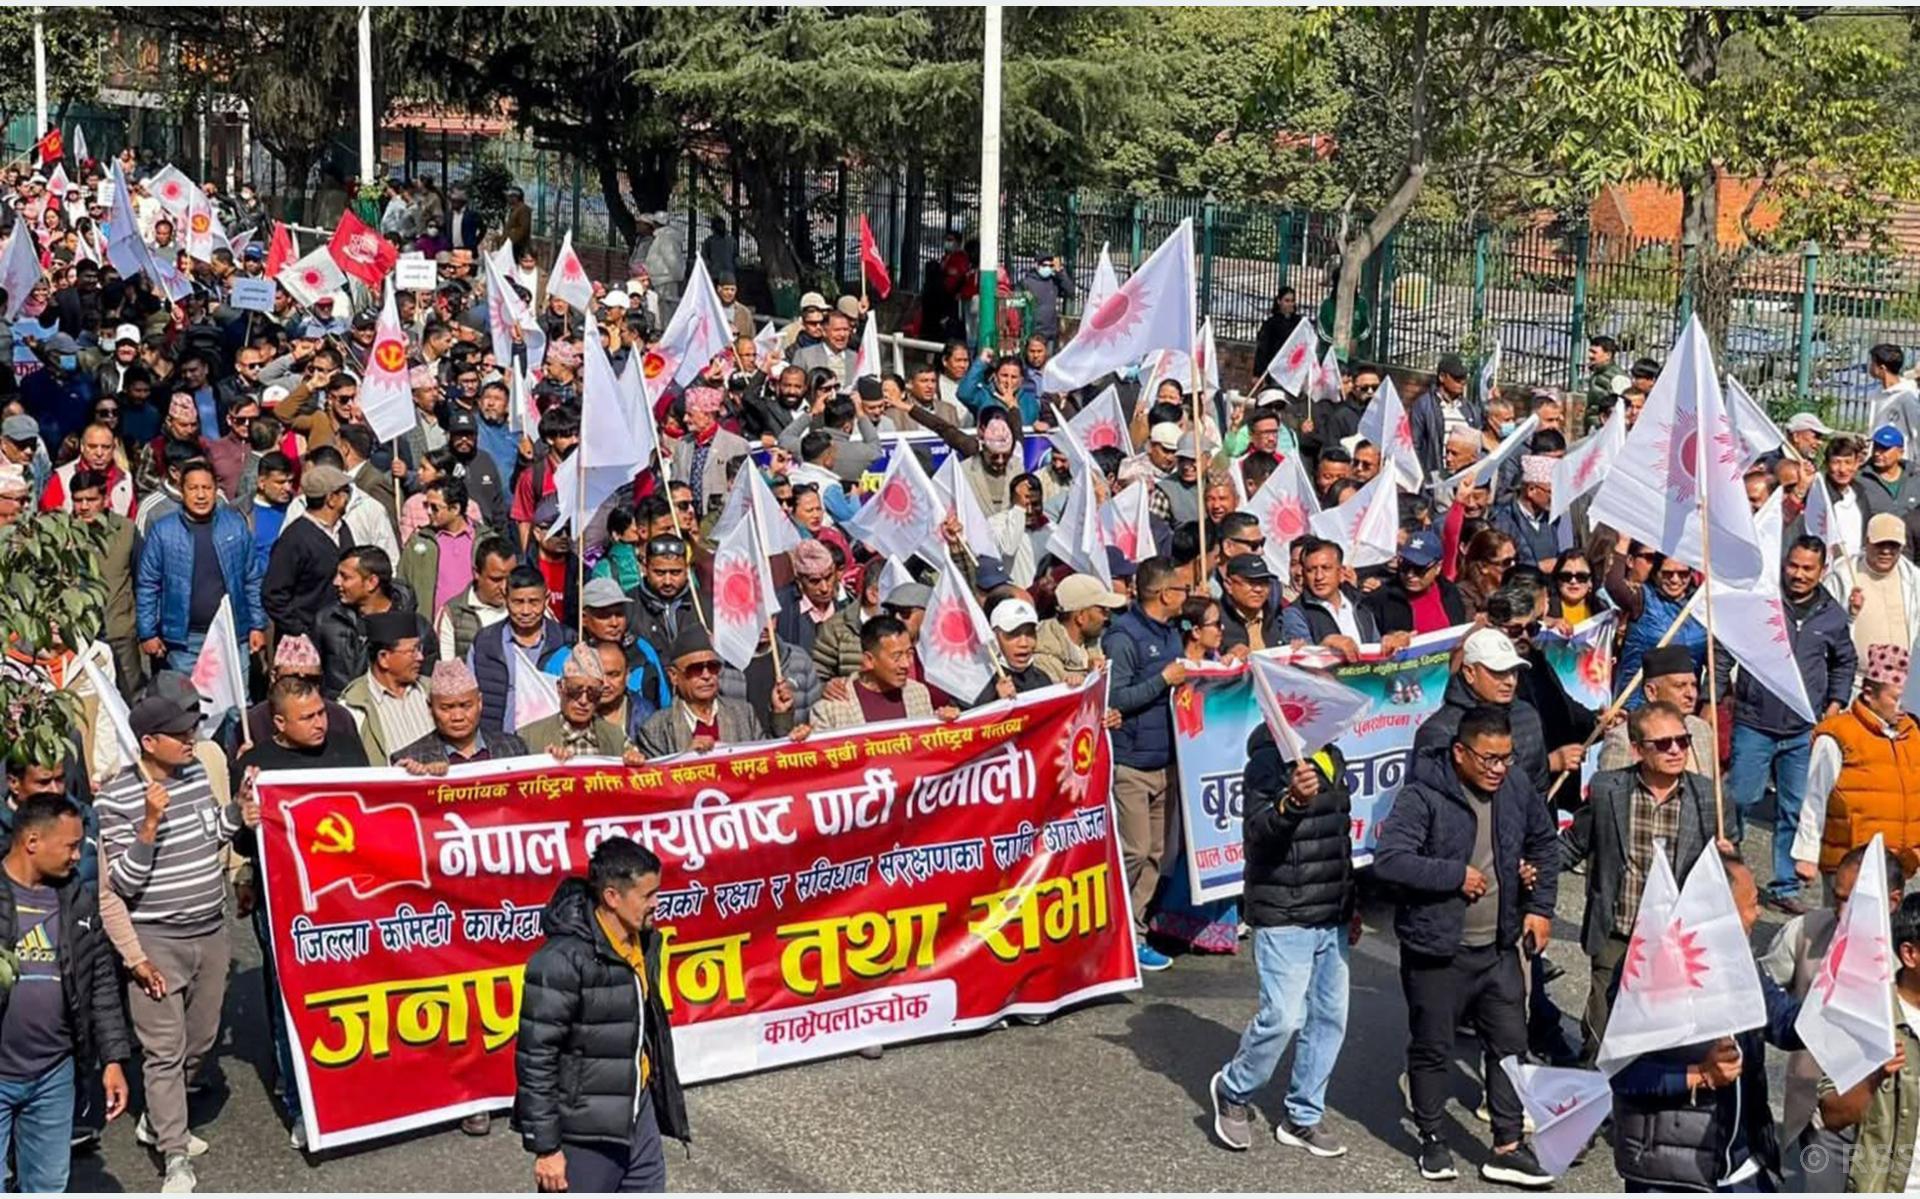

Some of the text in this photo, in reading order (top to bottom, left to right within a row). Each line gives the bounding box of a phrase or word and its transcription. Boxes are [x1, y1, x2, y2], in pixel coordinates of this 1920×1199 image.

[776, 750, 818, 770] नेपाल
[824, 742, 858, 769] सुखी
[864, 733, 913, 757] नेपाली
[434, 812, 573, 877] नेपाल
[807, 768, 899, 837] पार्टी
[291, 914, 373, 966] जिल्ला
[376, 902, 456, 953] कमिटी
[714, 878, 763, 918] रक्षा
[770, 874, 791, 909] र
[777, 902, 949, 998] तथा
[968, 863, 1110, 961] सभा
